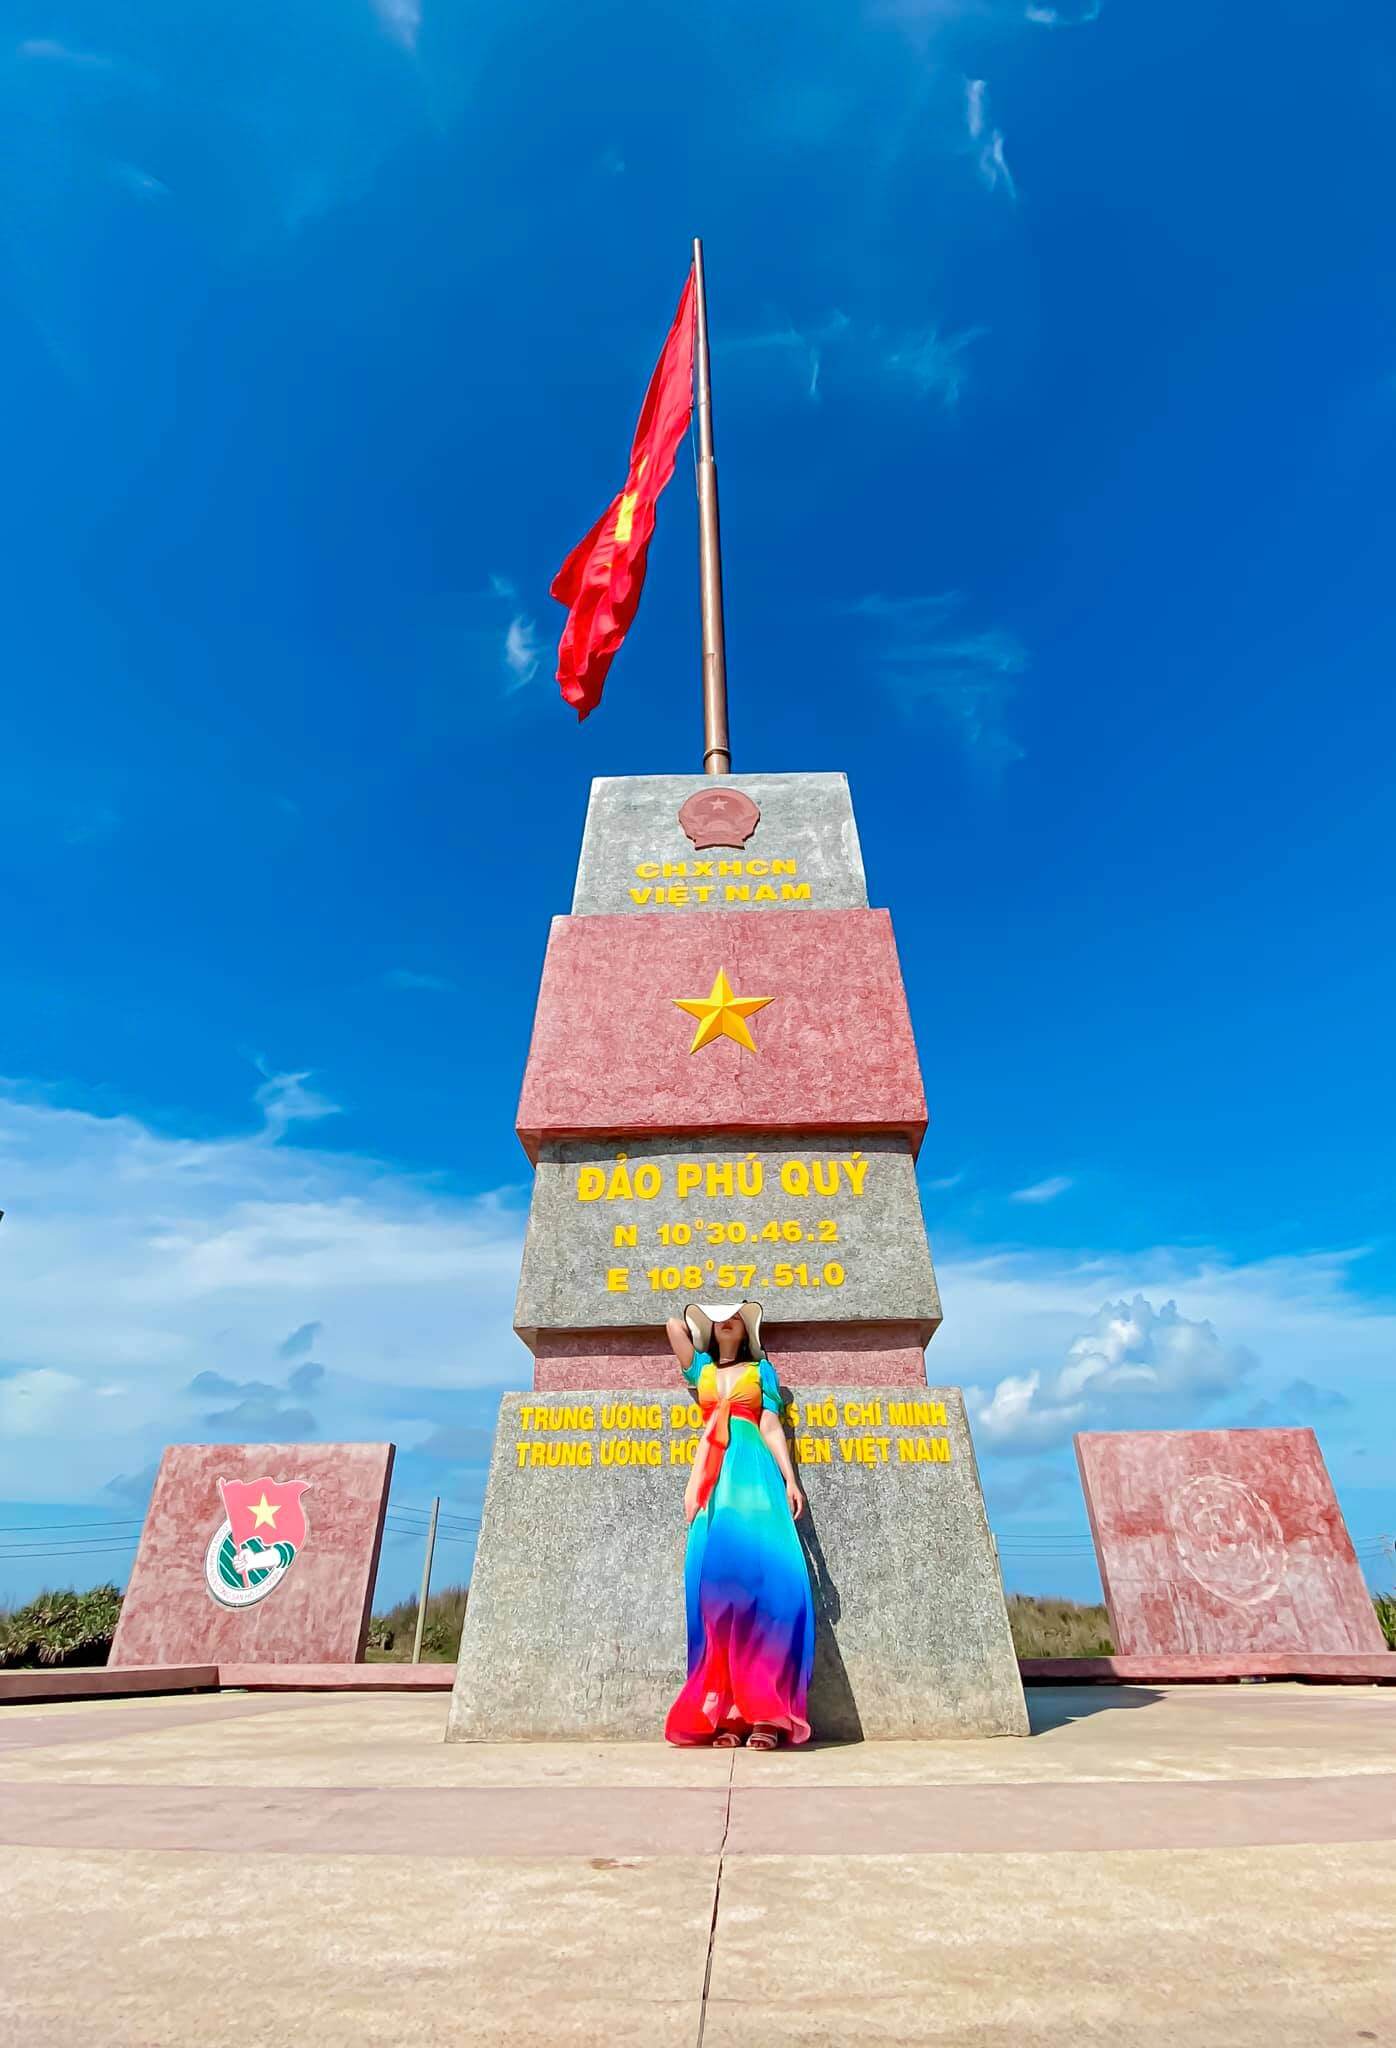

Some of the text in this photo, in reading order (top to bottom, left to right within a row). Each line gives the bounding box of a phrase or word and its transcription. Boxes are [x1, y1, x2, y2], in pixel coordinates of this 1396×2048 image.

[635, 859, 797, 880] CHXHCN
[629, 882, 812, 908] VIỆT NAM
[577, 1152, 868, 1202] ĐẢO PHÚ QUÝ
[613, 1225, 638, 1249] N
[607, 1268, 629, 1293] E
[519, 1405, 596, 1432] TRUNG
[600, 1402, 664, 1431] ƯƠNG
[669, 1403, 706, 1430] ĐO
[843, 1398, 882, 1428] CHÍ
[887, 1402, 948, 1428] MINH
[515, 1440, 593, 1469] TRUNG
[599, 1435, 663, 1467] ƯƠNG
[786, 1433, 833, 1465] IÊN
[838, 1431, 892, 1470] VIỆT
[897, 1436, 951, 1465] NAM
